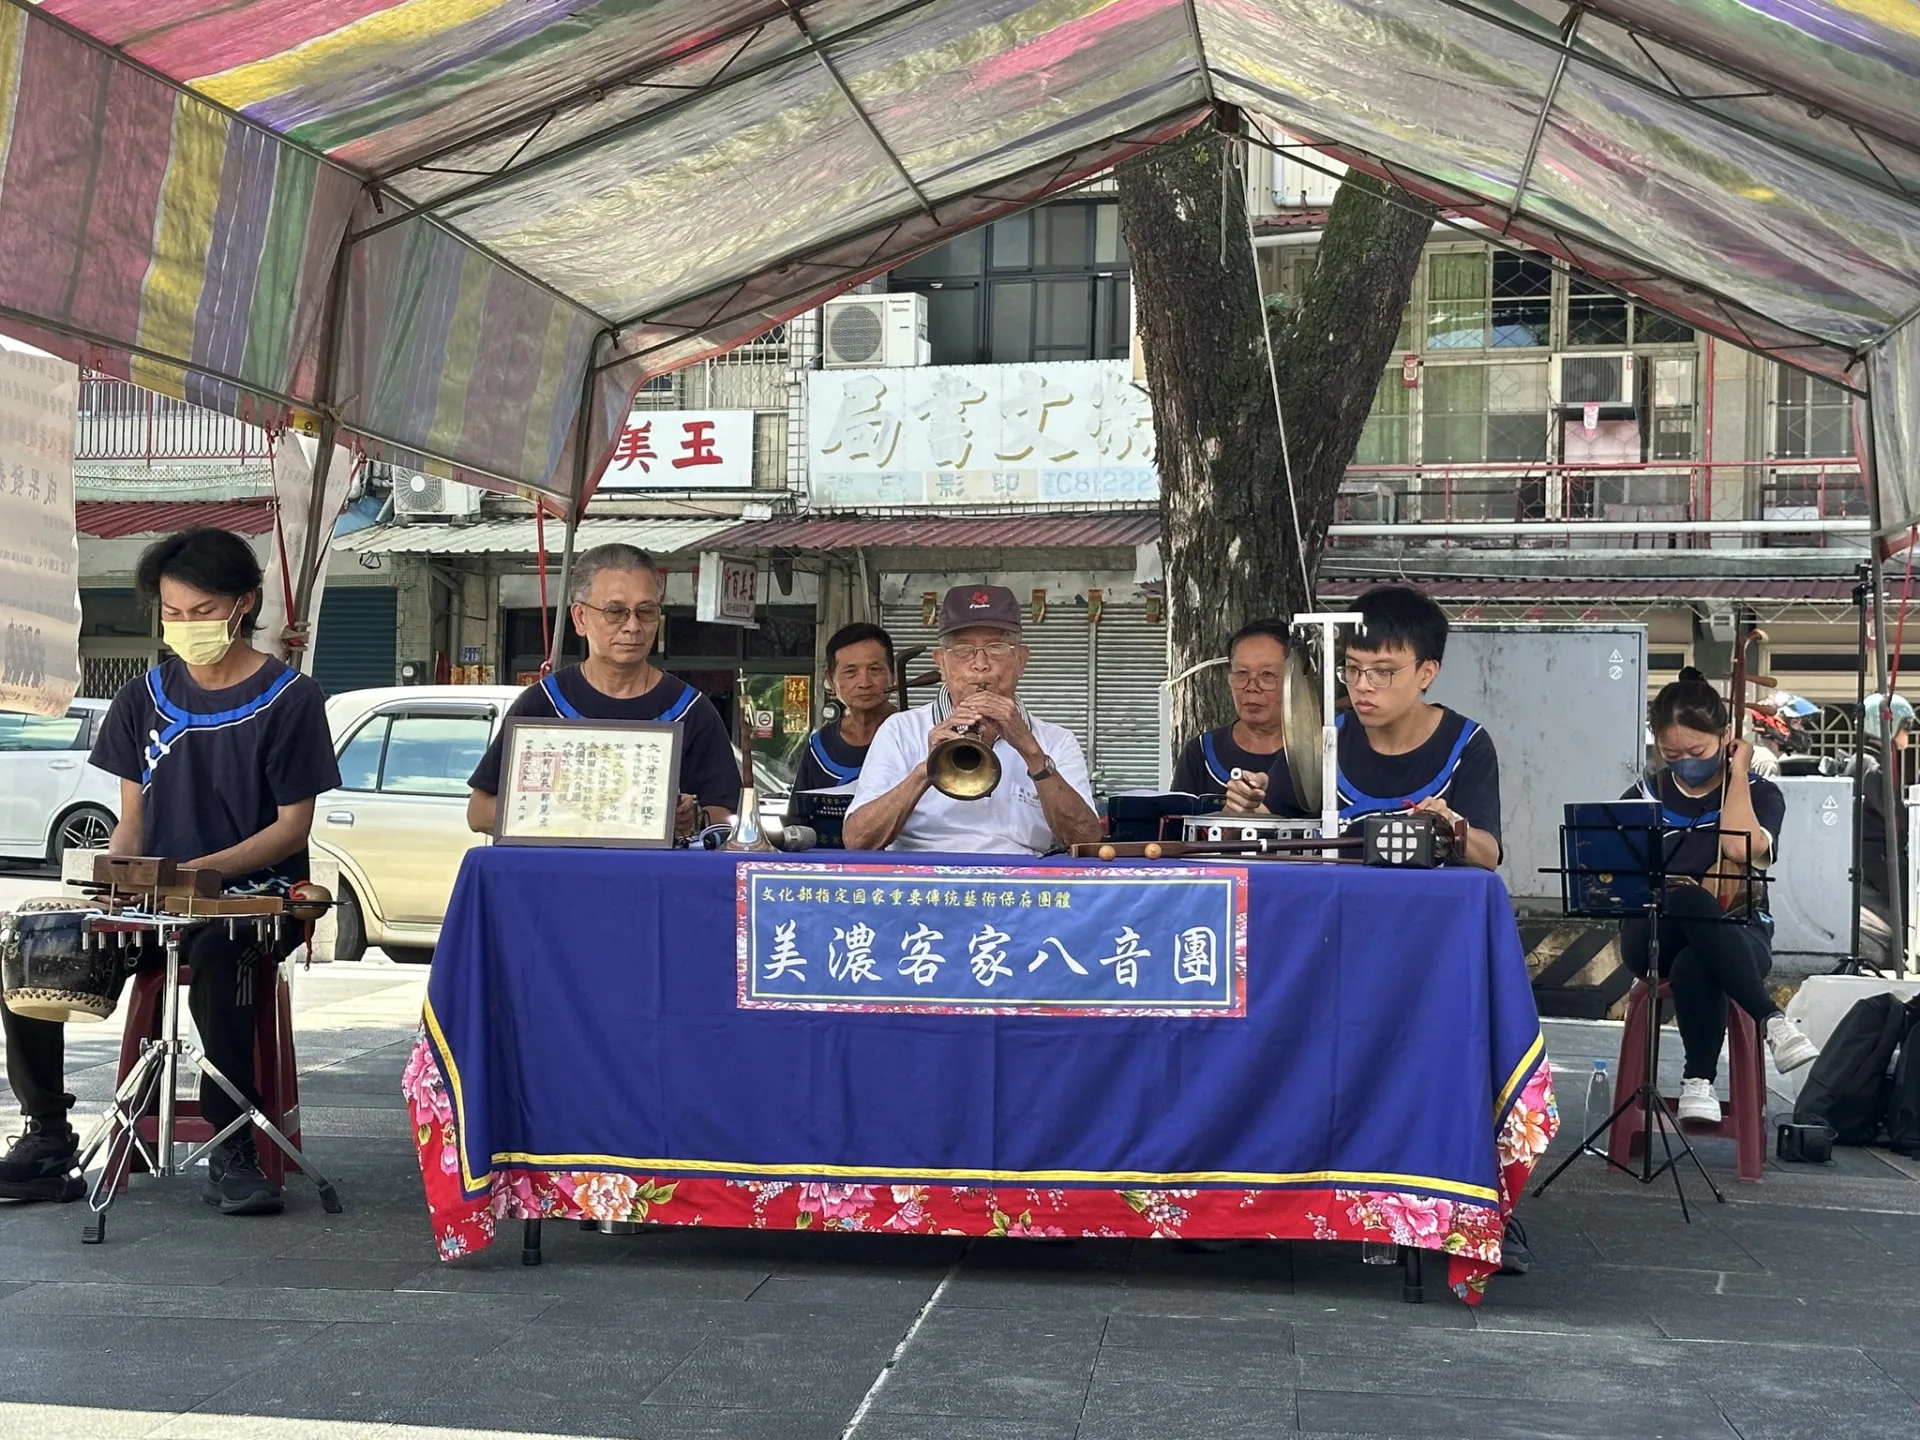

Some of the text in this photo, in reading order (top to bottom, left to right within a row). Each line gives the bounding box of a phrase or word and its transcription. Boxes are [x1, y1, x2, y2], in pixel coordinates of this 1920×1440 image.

[763, 918, 1218, 988] 美濃客家八音團
